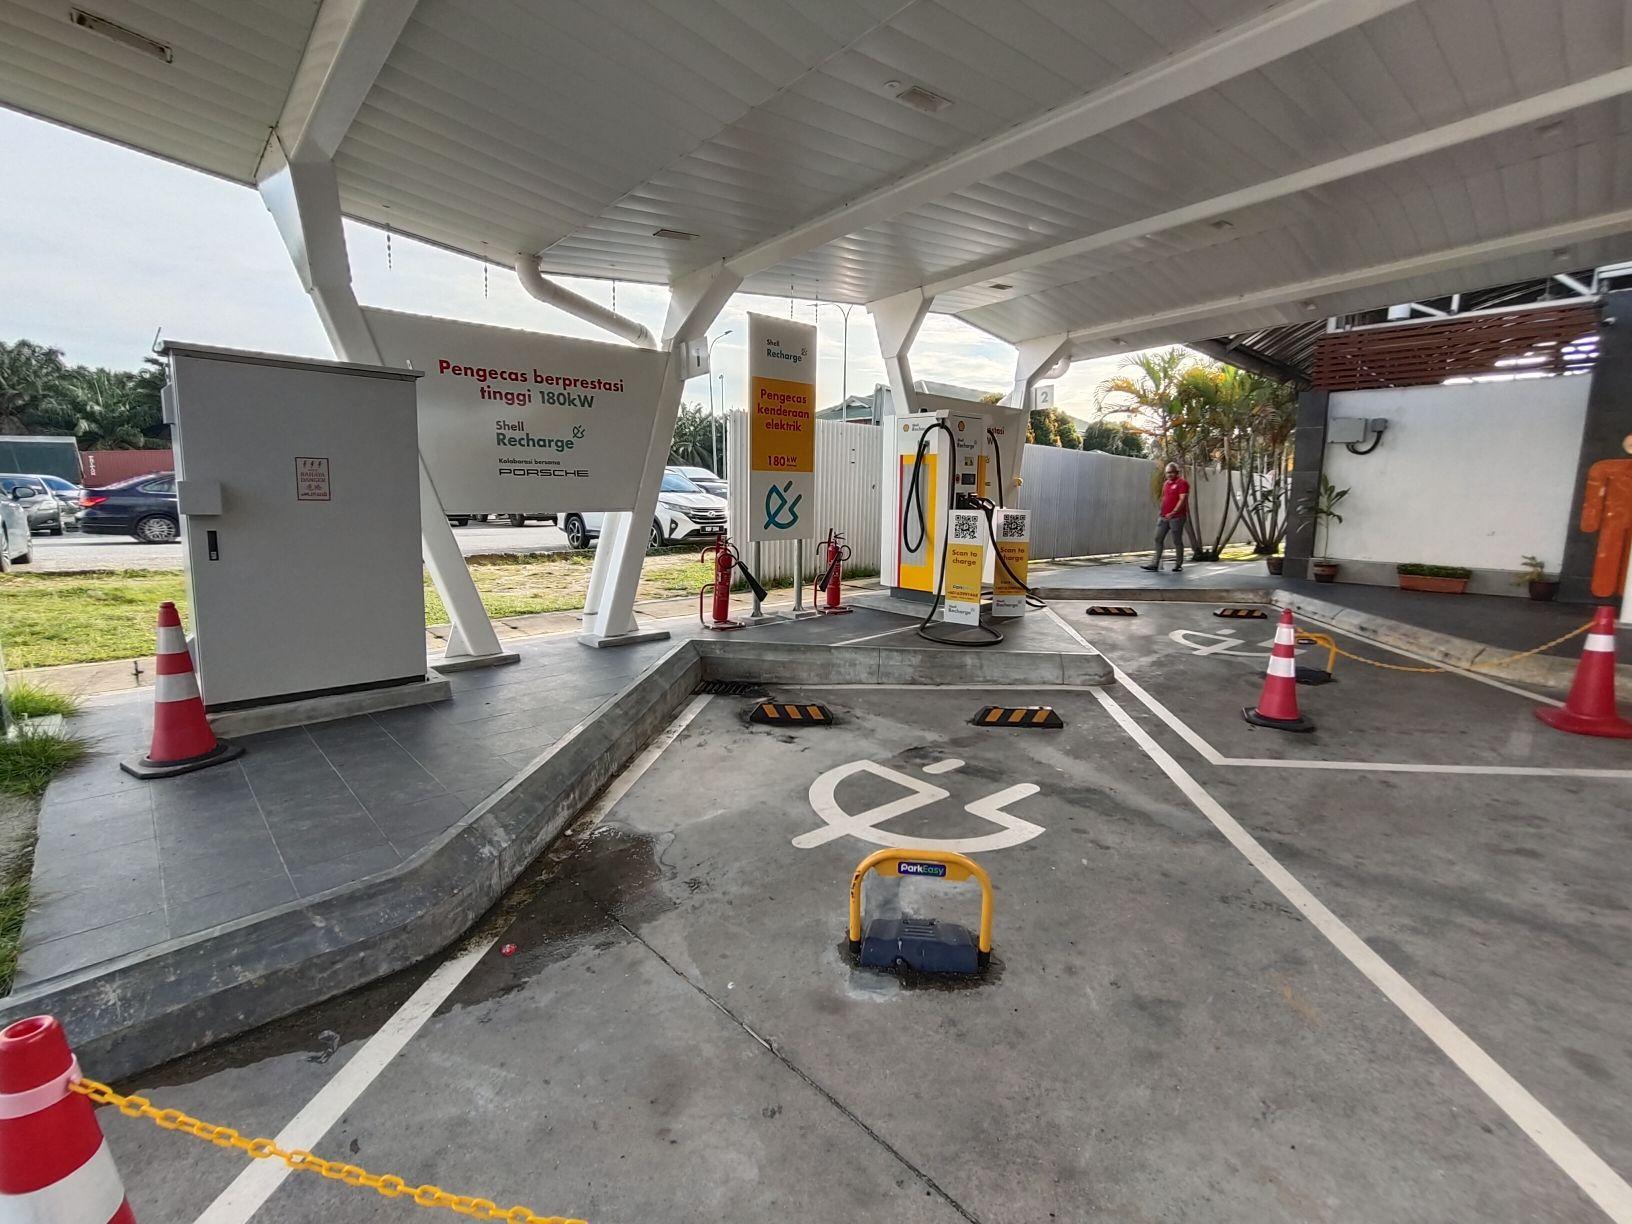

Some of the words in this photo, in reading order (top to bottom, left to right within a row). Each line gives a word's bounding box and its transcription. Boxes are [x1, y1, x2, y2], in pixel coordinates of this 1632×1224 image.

[766, 338, 780, 347] Shell
[766, 348, 803, 364] Recharge
[438, 359, 528, 382] Pengecas
[533, 368, 625, 393] berprestasi
[479, 384, 532, 407] tinggi
[538, 390, 595, 408] 180kW
[760, 388, 808, 405] Pengecas
[1040, 391, 1049, 403] 2
[757, 402, 810, 420] kenderaan
[495, 420, 525, 433] Shell
[765, 418, 802, 432] elektrik
[496, 432, 575, 453] Recharge
[768, 455, 785, 467] 180
[786, 456, 797, 464] kW
[499, 468, 589, 478] PORSCHE
[952, 549, 969, 557] Scan
[1000, 546, 1016, 554] Scan
[952, 557, 977, 567] charge
[1002, 554, 1024, 563] harge
[900, 864, 945, 875] ParkEasy
